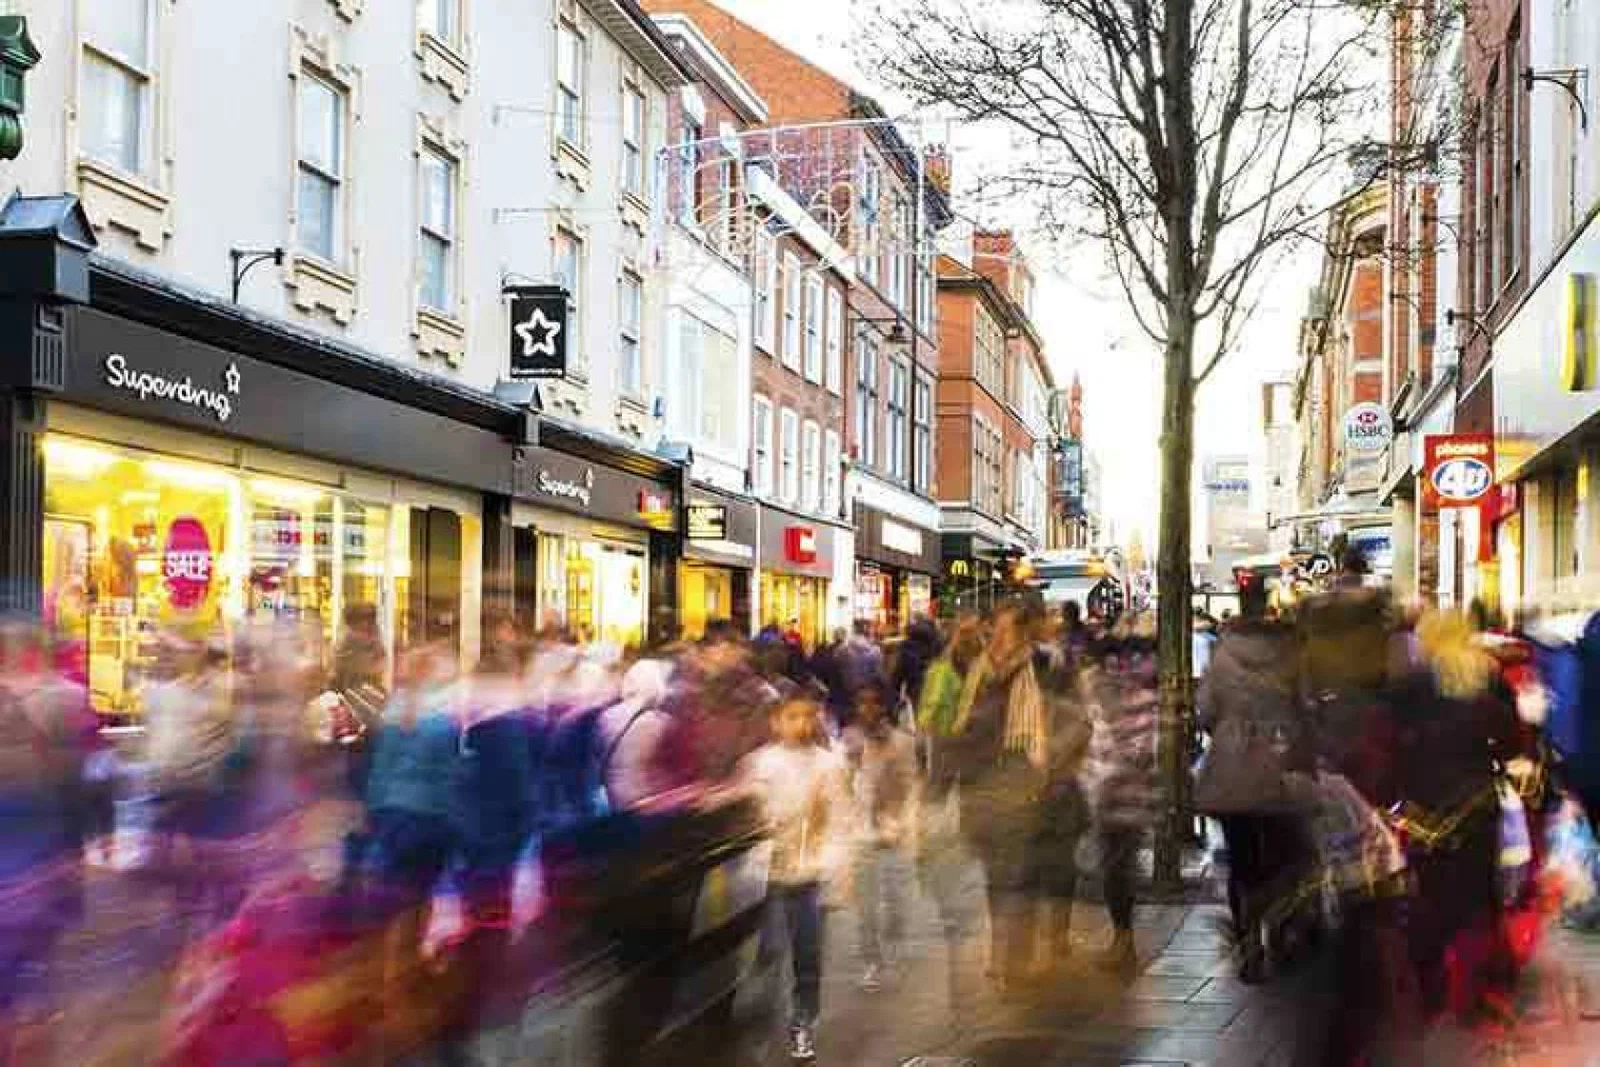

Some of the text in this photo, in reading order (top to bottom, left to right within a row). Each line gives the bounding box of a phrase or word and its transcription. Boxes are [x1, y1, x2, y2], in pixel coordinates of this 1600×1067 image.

[106, 353, 231, 422] Superdrug
[1348, 424, 1389, 439] HSBC
[1435, 441, 1489, 457] phones
[539, 470, 591, 506] Superdrug
[165, 551, 210, 582] SALE
